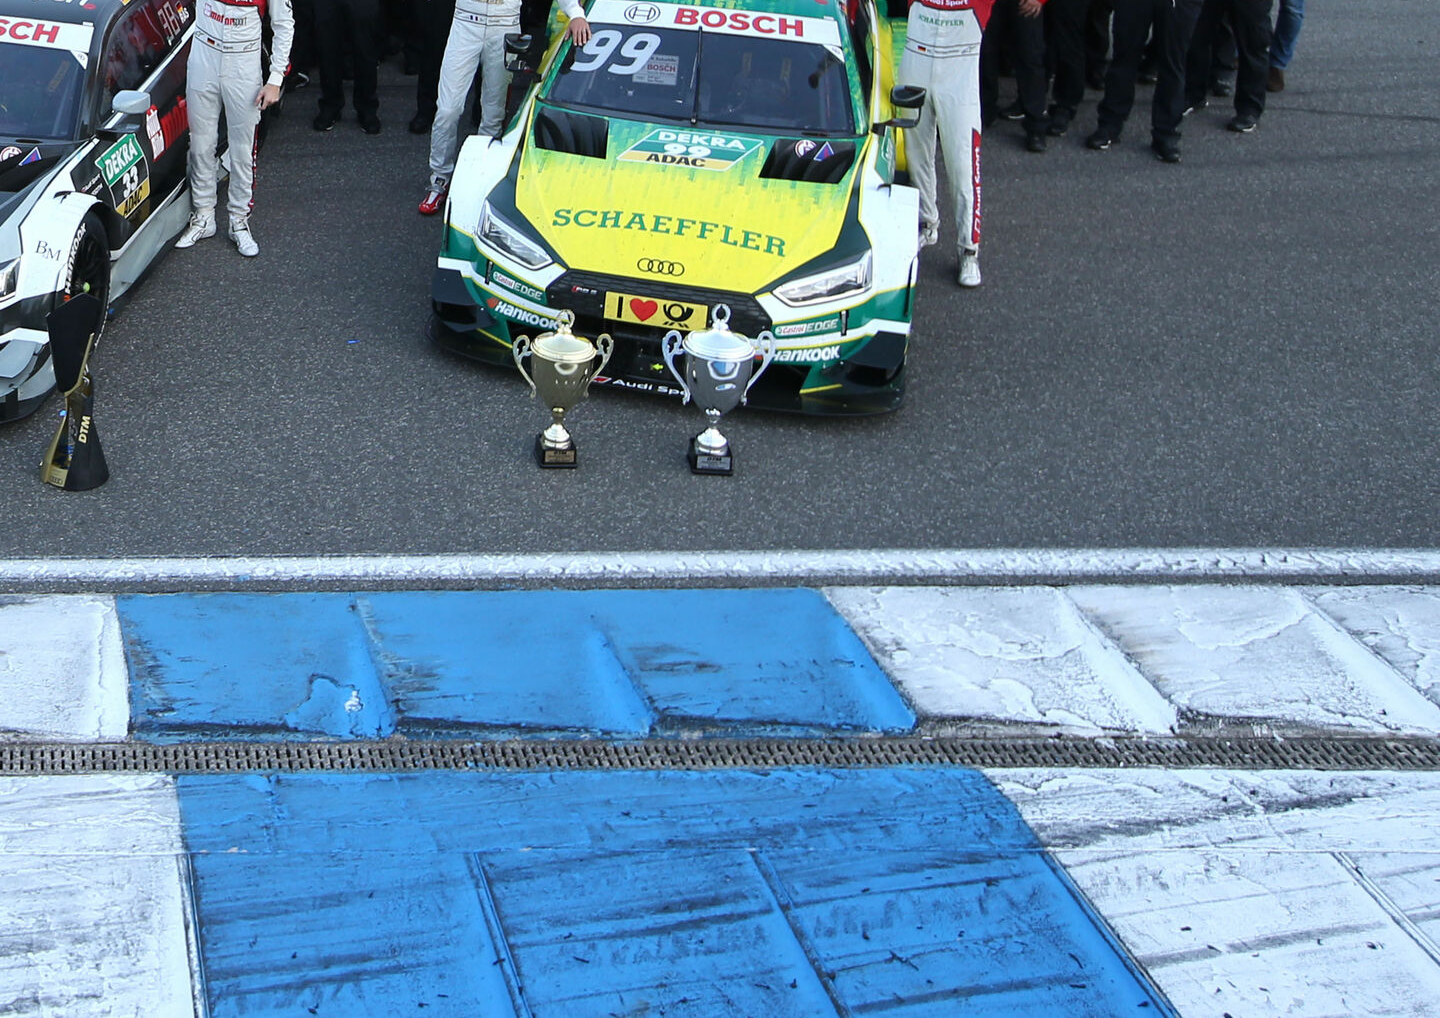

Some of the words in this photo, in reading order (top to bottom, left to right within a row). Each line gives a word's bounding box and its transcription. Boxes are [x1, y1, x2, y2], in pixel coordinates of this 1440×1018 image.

[673, 7, 804, 37] BOSCH
[569, 29, 661, 75] 99
[646, 63, 677, 73] BOSCH
[658, 130, 746, 150] DEKRA
[663, 142, 712, 157] 99
[105, 138, 138, 181] DEKRA
[646, 153, 707, 168] ADAC
[122, 165, 139, 198] 33
[552, 208, 787, 257] SCHAEFFLER
[513, 282, 543, 301] EDGE
[782, 325, 804, 335] Castrol
[805, 319, 839, 333] EDGE
[612, 379, 654, 391] Audi
[78, 415, 91, 444] DTM
